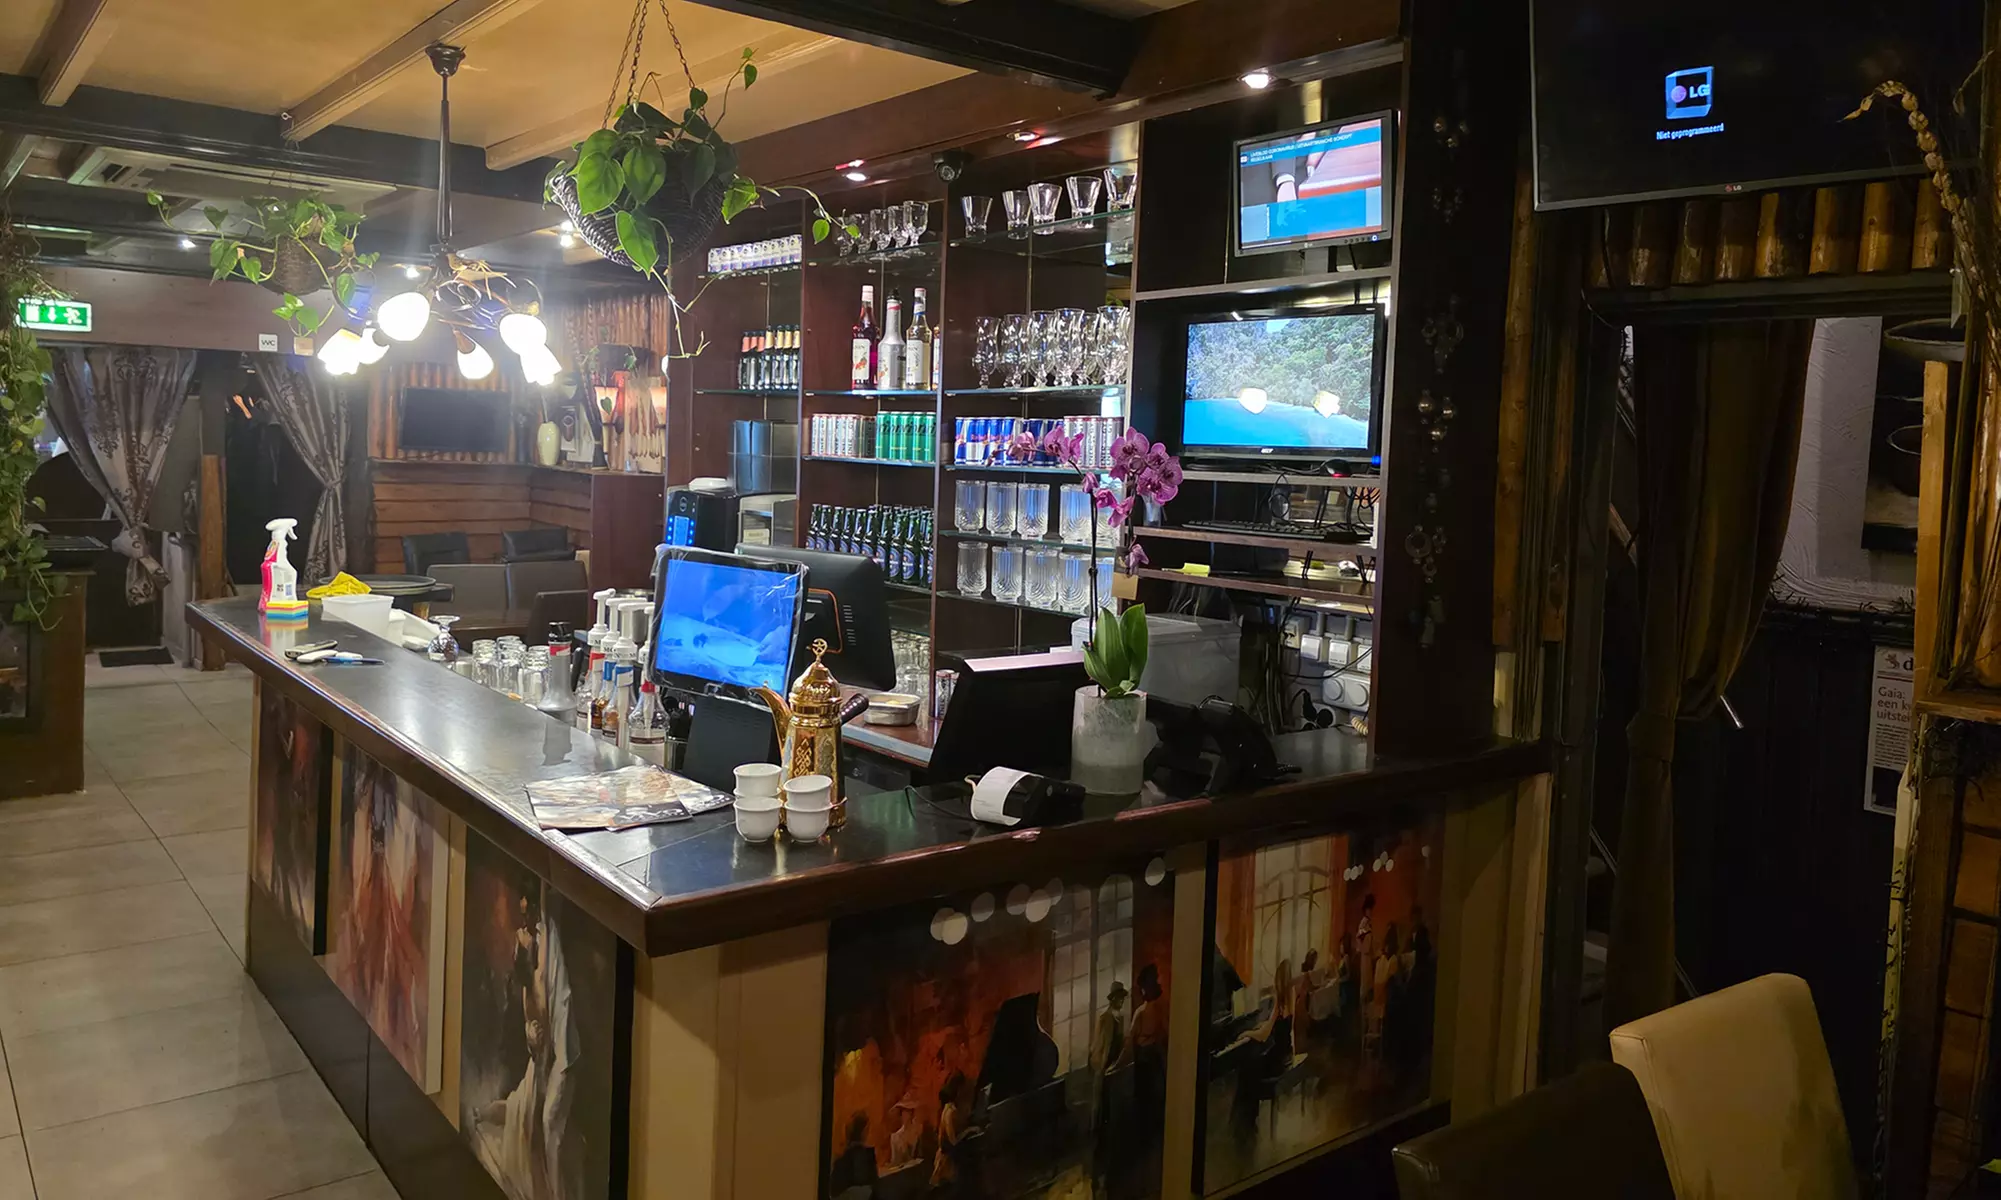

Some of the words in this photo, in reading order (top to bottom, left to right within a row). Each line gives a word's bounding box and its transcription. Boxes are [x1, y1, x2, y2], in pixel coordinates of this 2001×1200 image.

[1689, 83, 1711, 98] LG
[1656, 130, 1671, 140] Niet
[1671, 123, 1724, 139] geprogrammeerd
[1903, 656, 1914, 671] d
[1878, 686, 1906, 699] Gaia:
[1877, 699, 1898, 709] een
